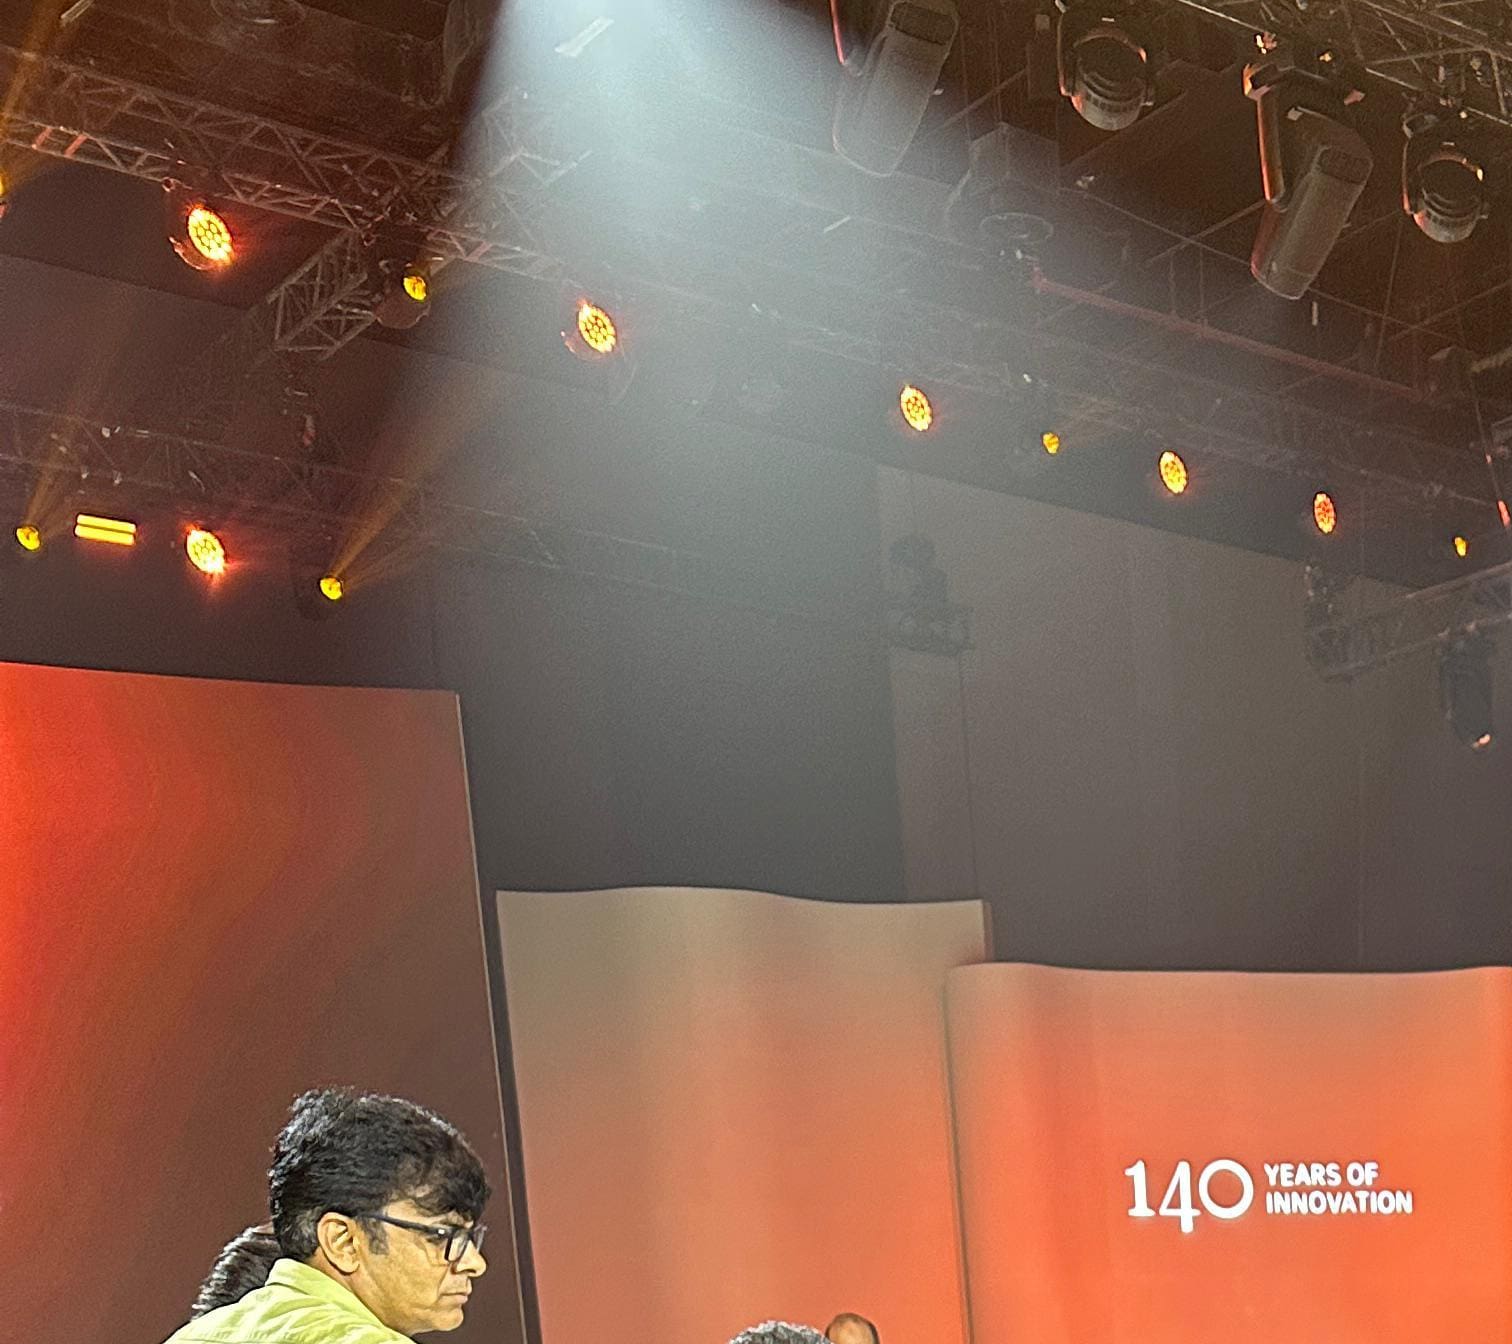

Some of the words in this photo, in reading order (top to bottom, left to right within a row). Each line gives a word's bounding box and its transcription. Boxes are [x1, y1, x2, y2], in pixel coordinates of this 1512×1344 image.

[1263, 1162, 1341, 1187] YEARS
[1346, 1162, 1379, 1187] OF
[1124, 1159, 1254, 1234] 140
[1265, 1190, 1413, 1215] INNOVATION
